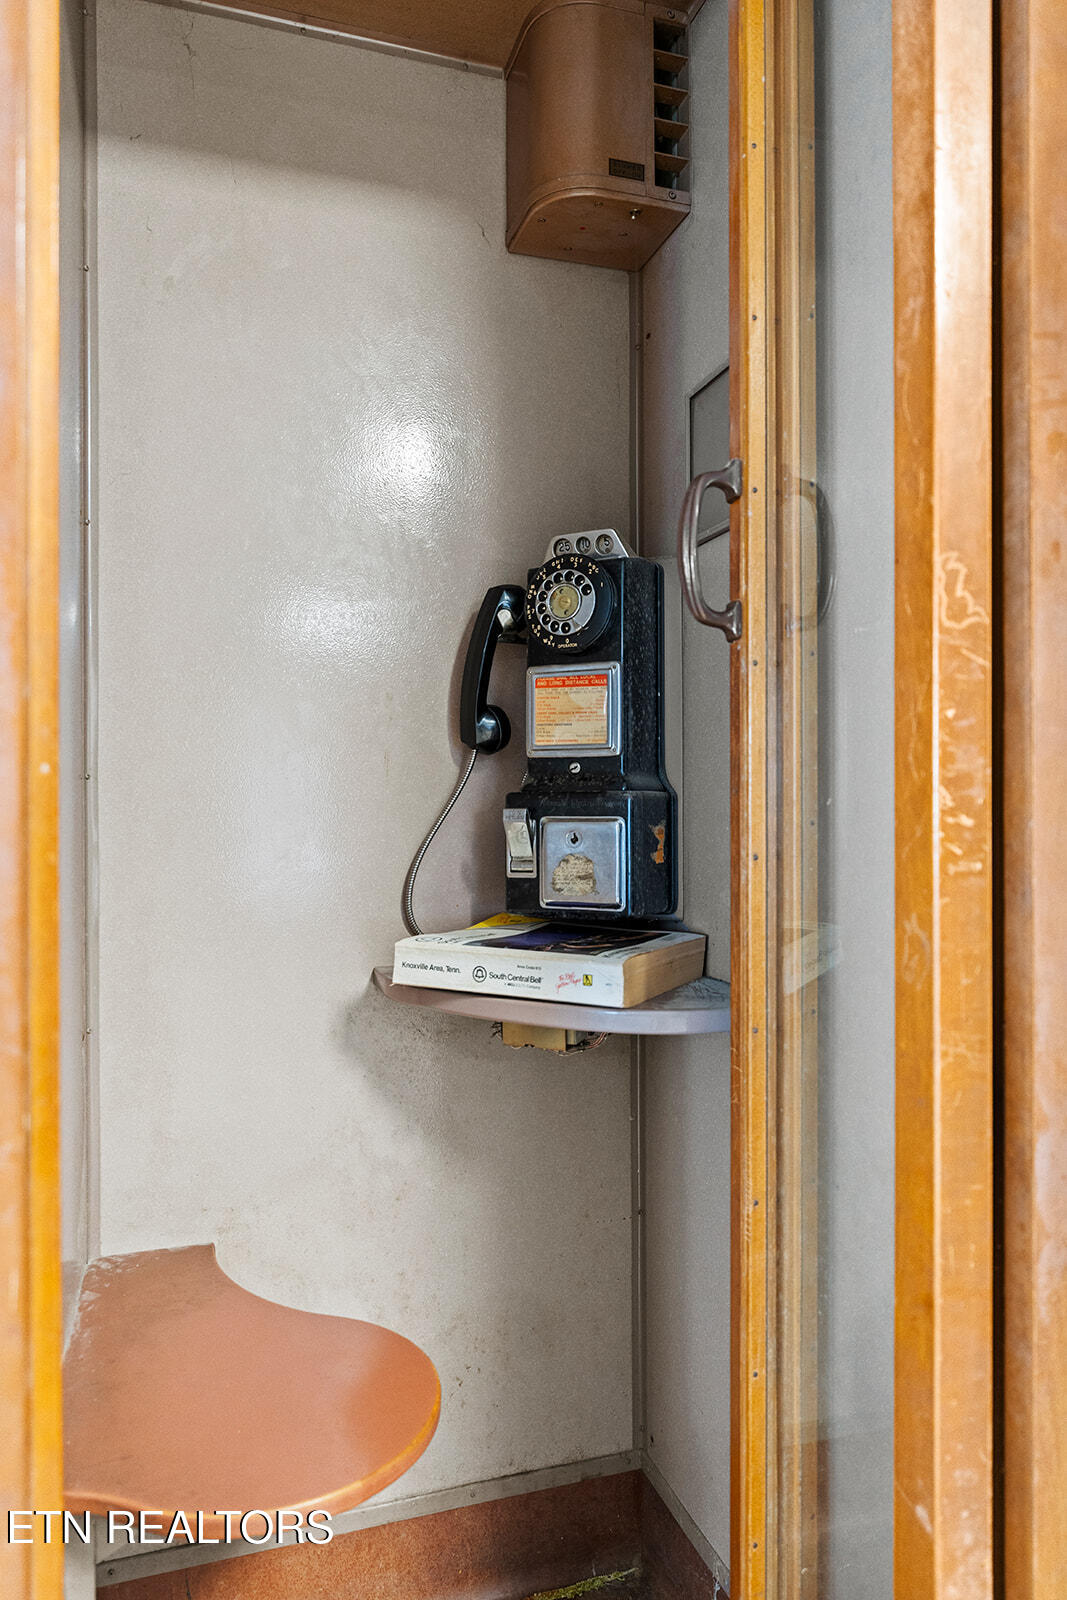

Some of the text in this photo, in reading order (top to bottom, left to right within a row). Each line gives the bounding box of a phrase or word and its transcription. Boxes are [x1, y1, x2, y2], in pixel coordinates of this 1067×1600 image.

[559, 538, 610, 552] 25 10 5
[402, 961, 461, 974] Knoxville Area, Tenn.
[489, 971, 542, 984] South Central Bell
